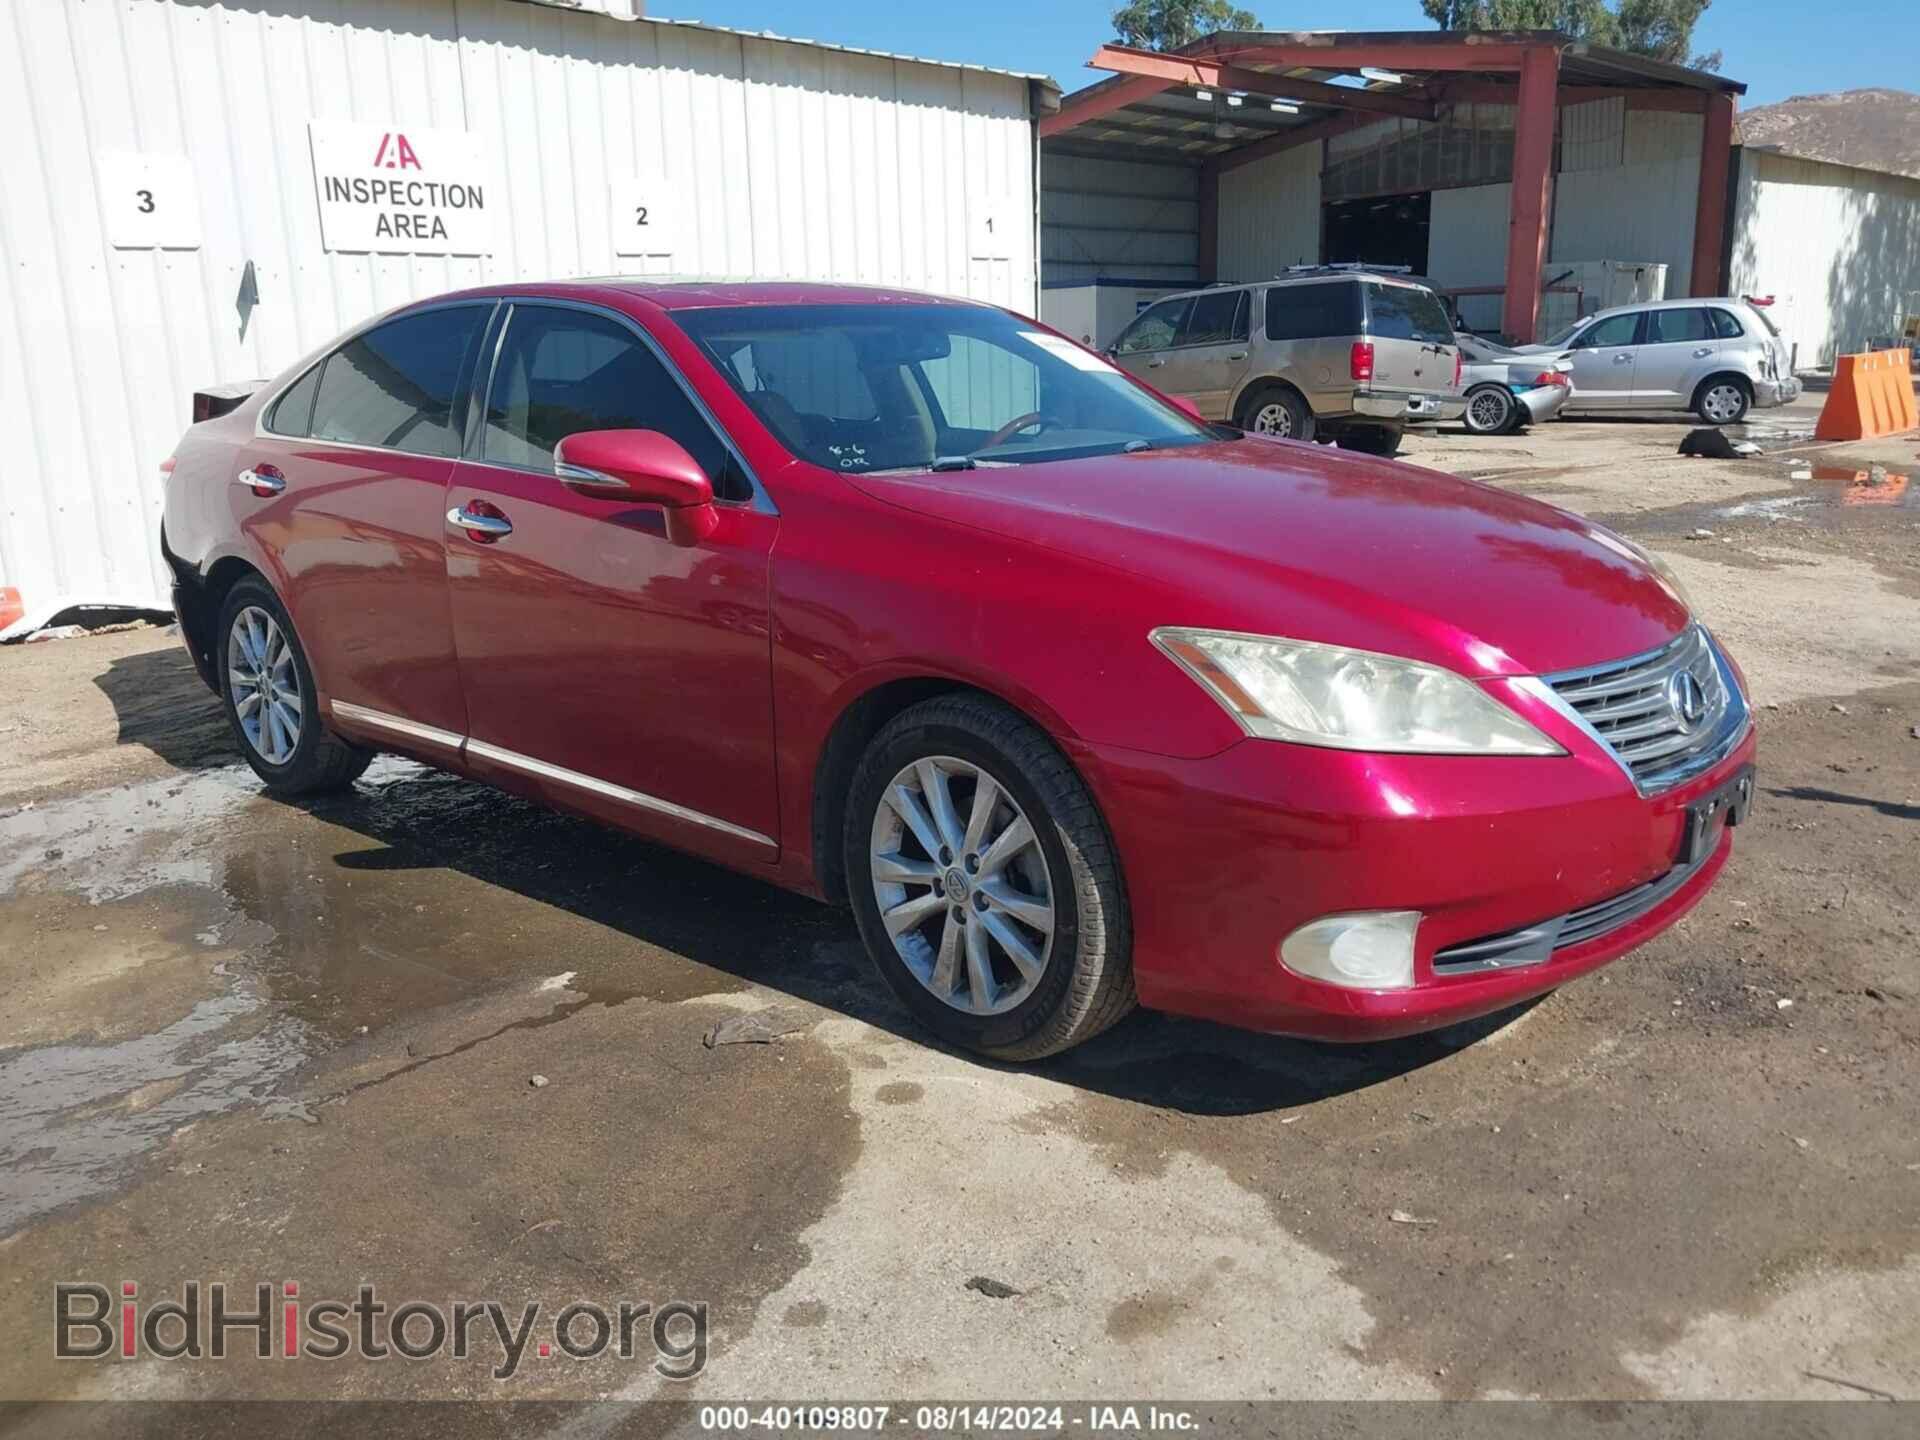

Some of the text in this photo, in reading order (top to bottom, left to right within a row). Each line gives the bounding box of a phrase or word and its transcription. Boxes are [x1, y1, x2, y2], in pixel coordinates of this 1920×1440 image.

[136, 190, 155, 214] 3
[324, 176, 484, 210] INSPECTION
[375, 213, 448, 240] AREA
[636, 206, 649, 226] 2
[986, 217, 994, 234] 1
